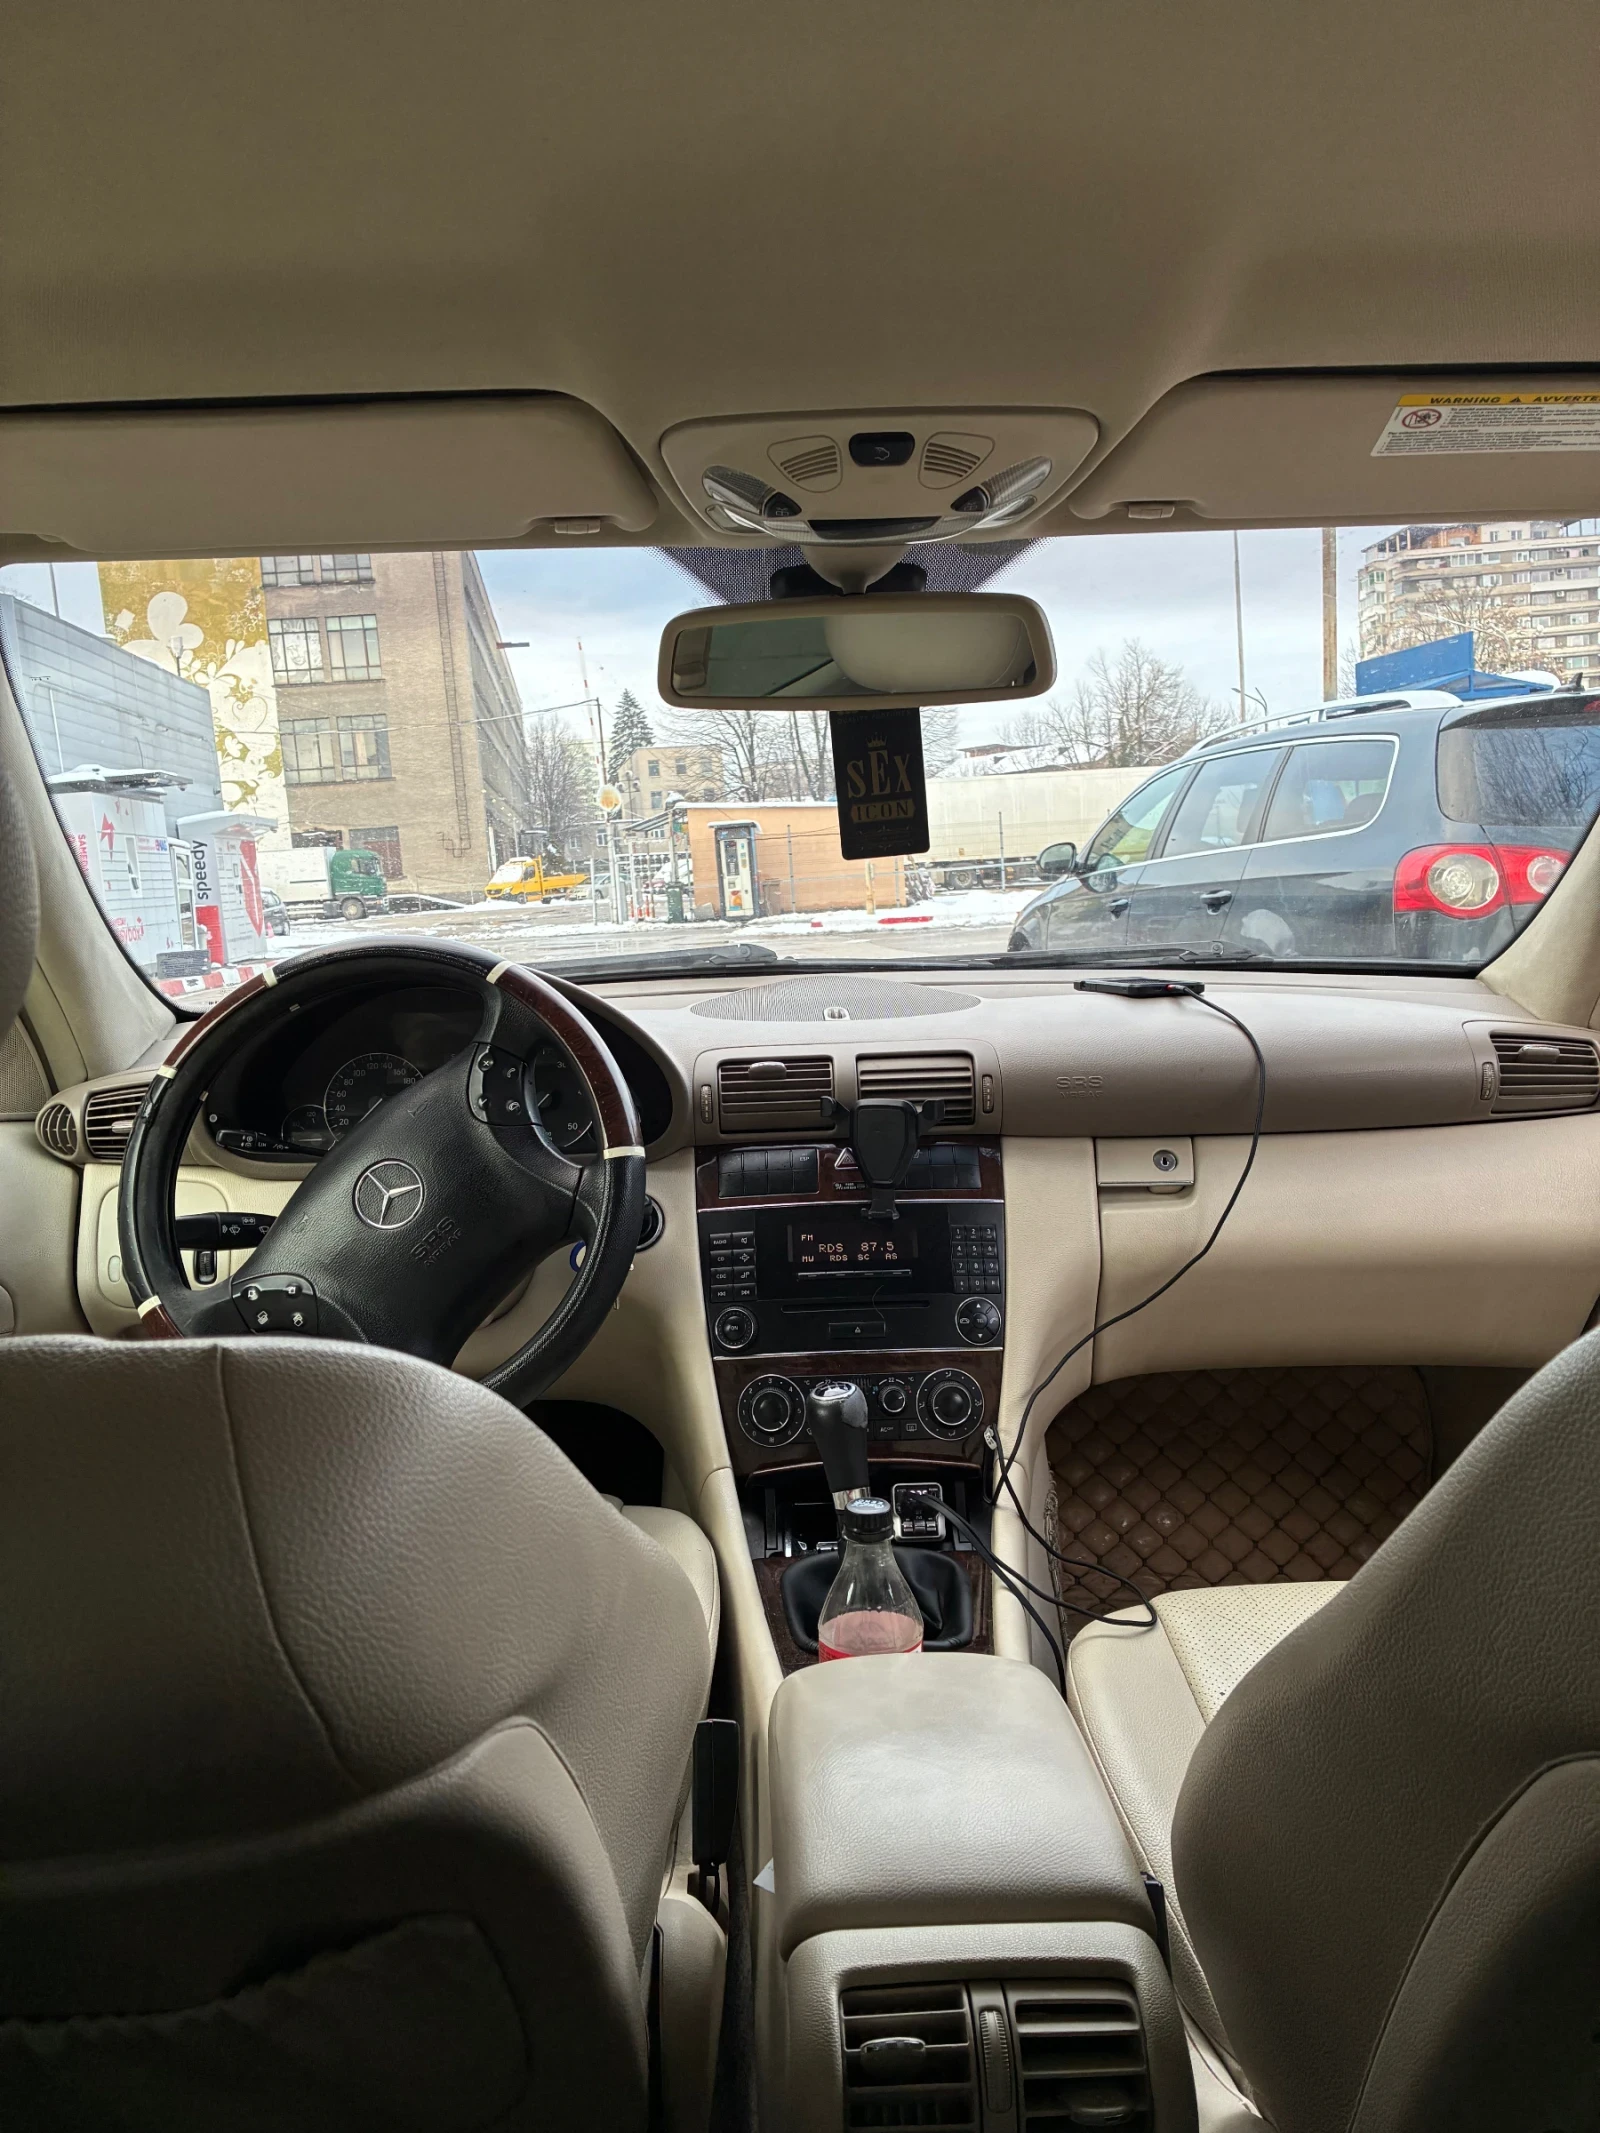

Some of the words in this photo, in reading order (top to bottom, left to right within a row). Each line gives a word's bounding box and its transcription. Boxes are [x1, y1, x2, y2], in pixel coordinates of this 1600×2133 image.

[1430, 396, 1501, 404] WARNING
[1533, 394, 1600, 403] AVVERTE
[846, 749, 913, 799] SEX
[856, 801, 909, 821] ICON
[190, 840, 212, 900] speedy
[353, 1069, 366, 1077] 100
[343, 1078, 354, 1086] 80
[1056, 1075, 1103, 1089] SRS
[336, 1090, 347, 1098] 60
[335, 1104, 346, 1112] 40
[339, 1118, 349, 1126] 20
[567, 1122, 578, 1130] 50
[410, 1216, 455, 1260] SRS
[818, 1242, 844, 1253] RDS
[860, 1241, 895, 1252] 87.5
[829, 1254, 848, 1262] RDS
[857, 1253, 870, 1261] SC
[885, 1252, 898, 1260] AS
